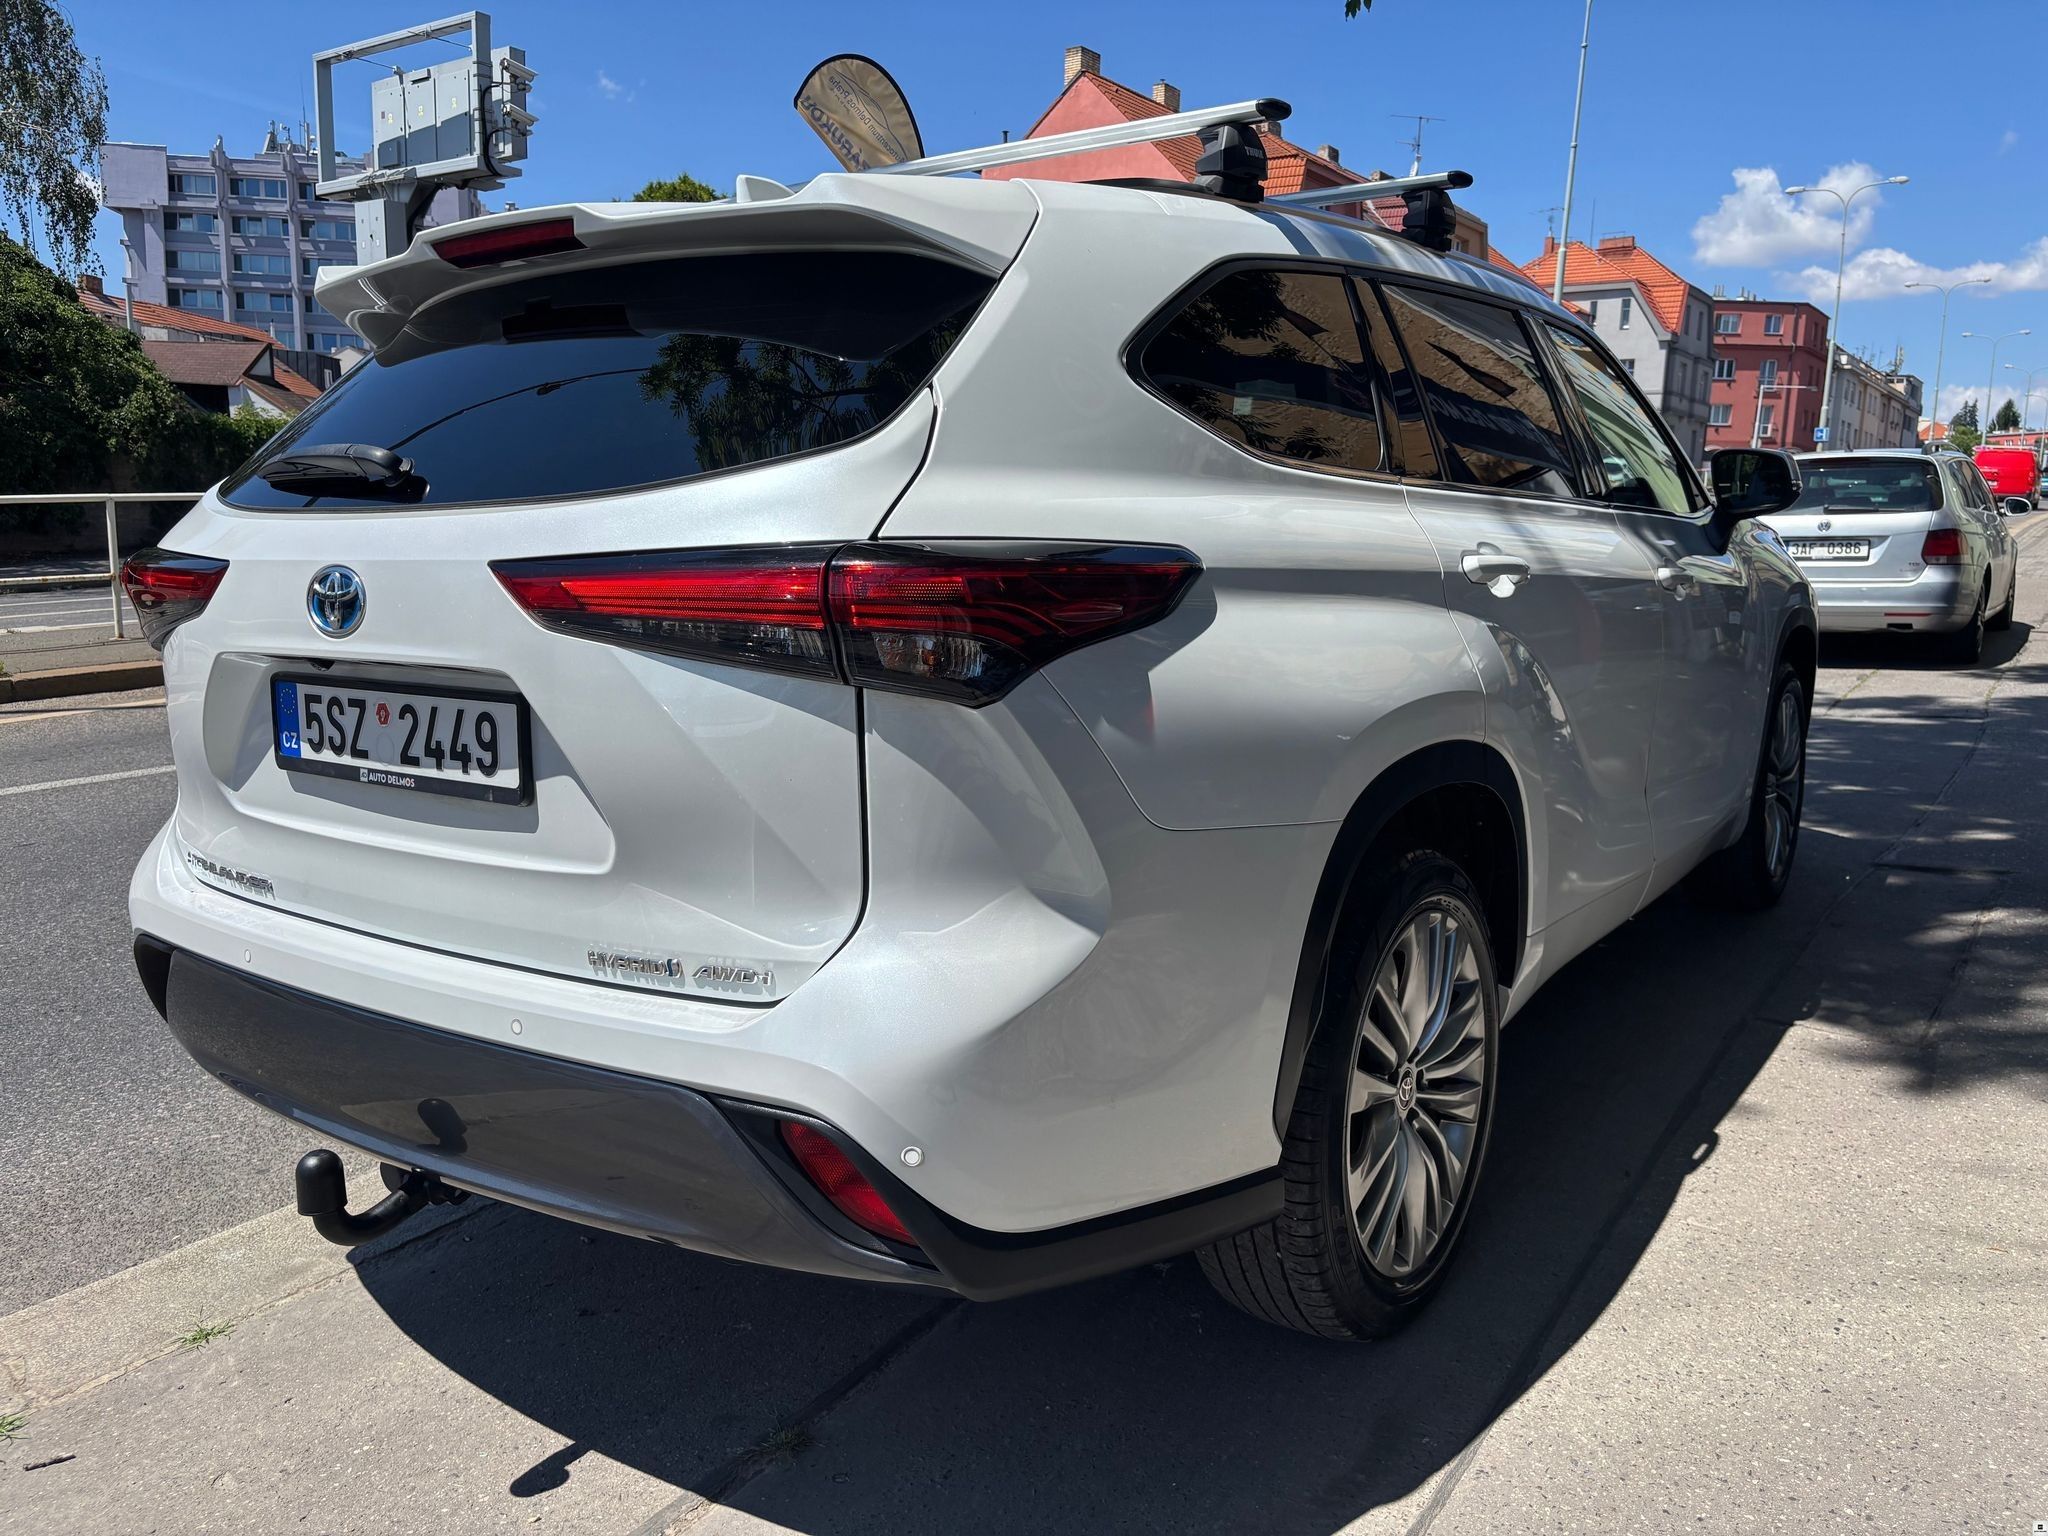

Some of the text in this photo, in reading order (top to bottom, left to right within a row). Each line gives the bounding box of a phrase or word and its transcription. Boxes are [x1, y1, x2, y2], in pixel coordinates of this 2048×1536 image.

[1792, 542, 1861, 555] 3AF 0386
[282, 731, 299, 749] CZ
[304, 693, 499, 778] 5SZ 2449
[368, 772, 415, 788] AUTO DELMOS
[587, 949, 668, 977] HYBRID
